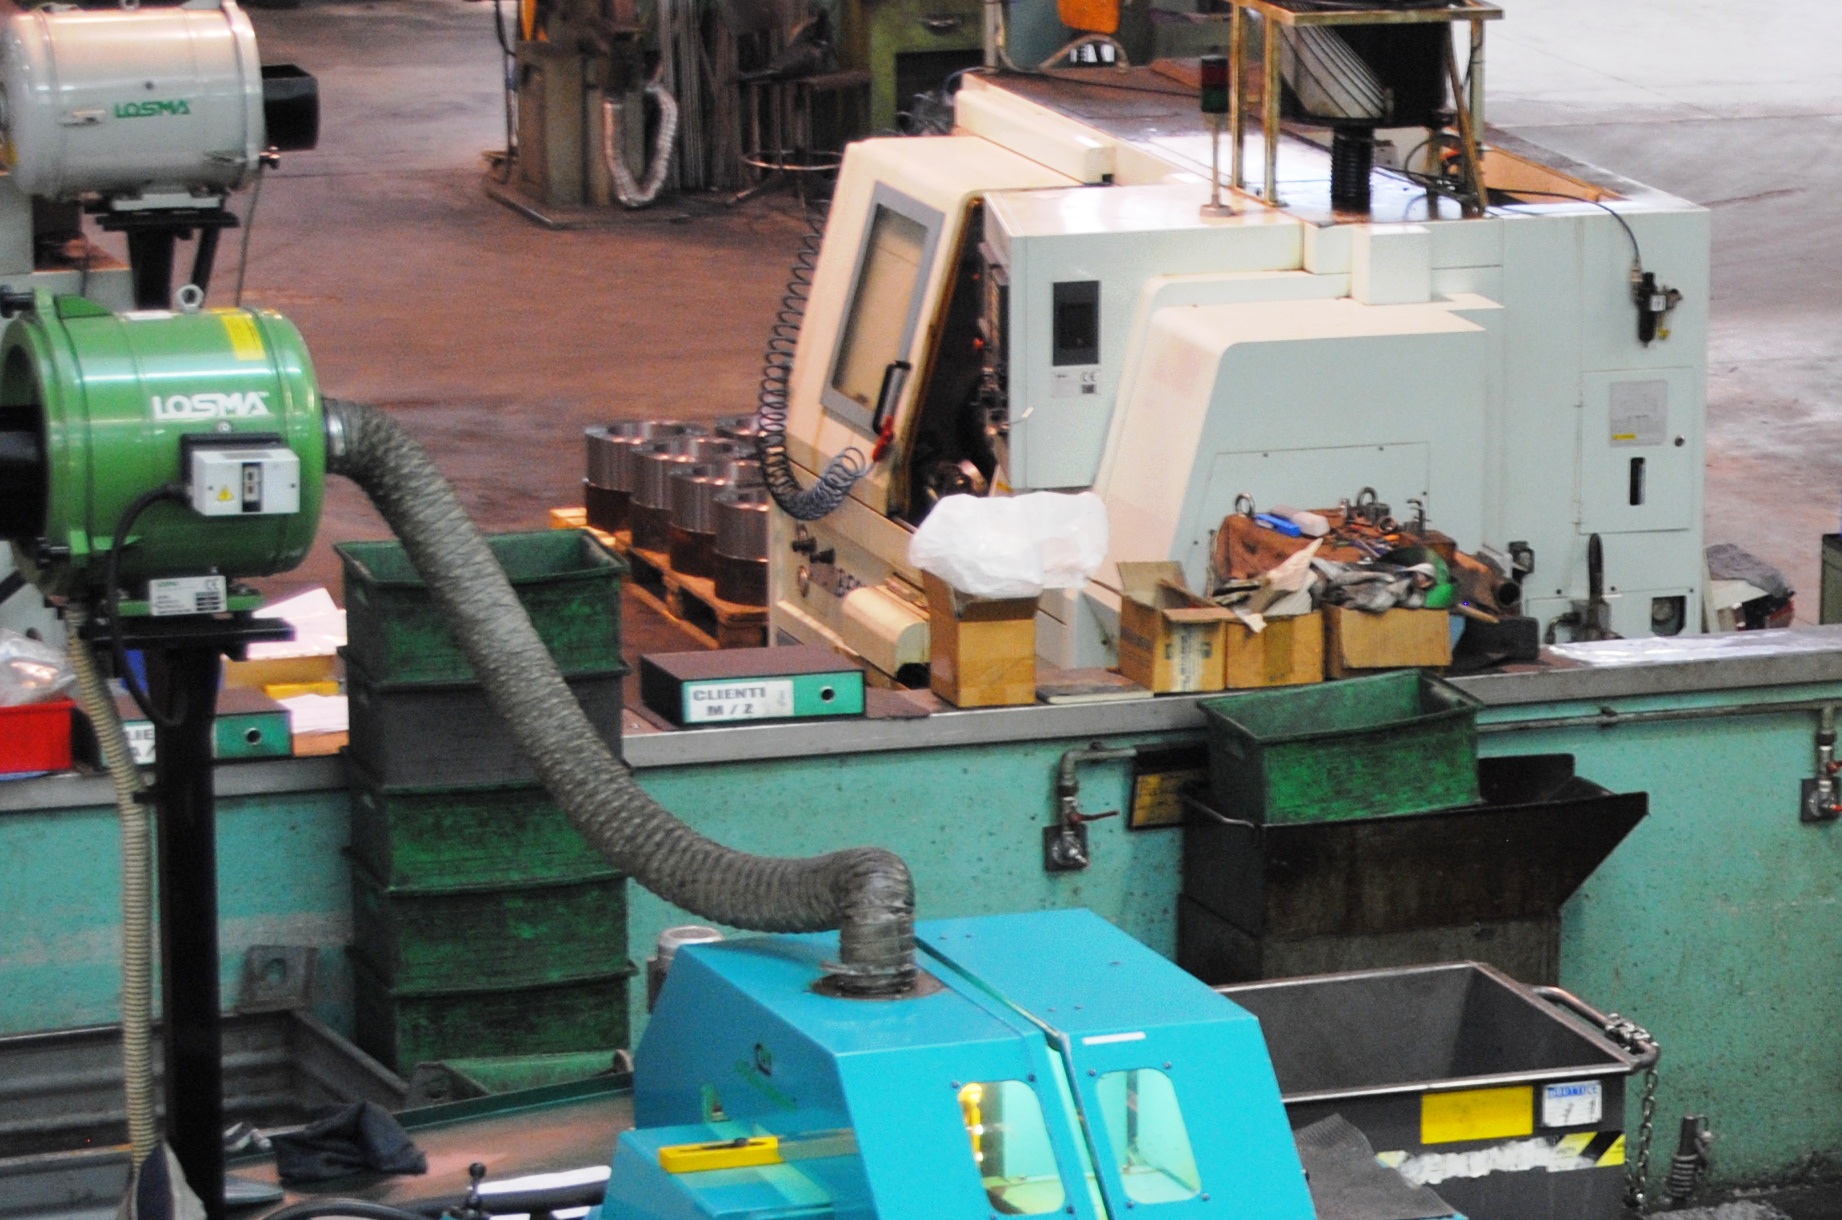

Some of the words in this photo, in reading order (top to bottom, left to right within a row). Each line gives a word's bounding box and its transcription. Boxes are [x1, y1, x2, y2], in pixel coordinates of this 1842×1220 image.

[114, 100, 192, 118] LOSMA
[152, 391, 270, 419] LOSMA
[693, 687, 766, 701] CLIENTI
[706, 705, 723, 716] M
